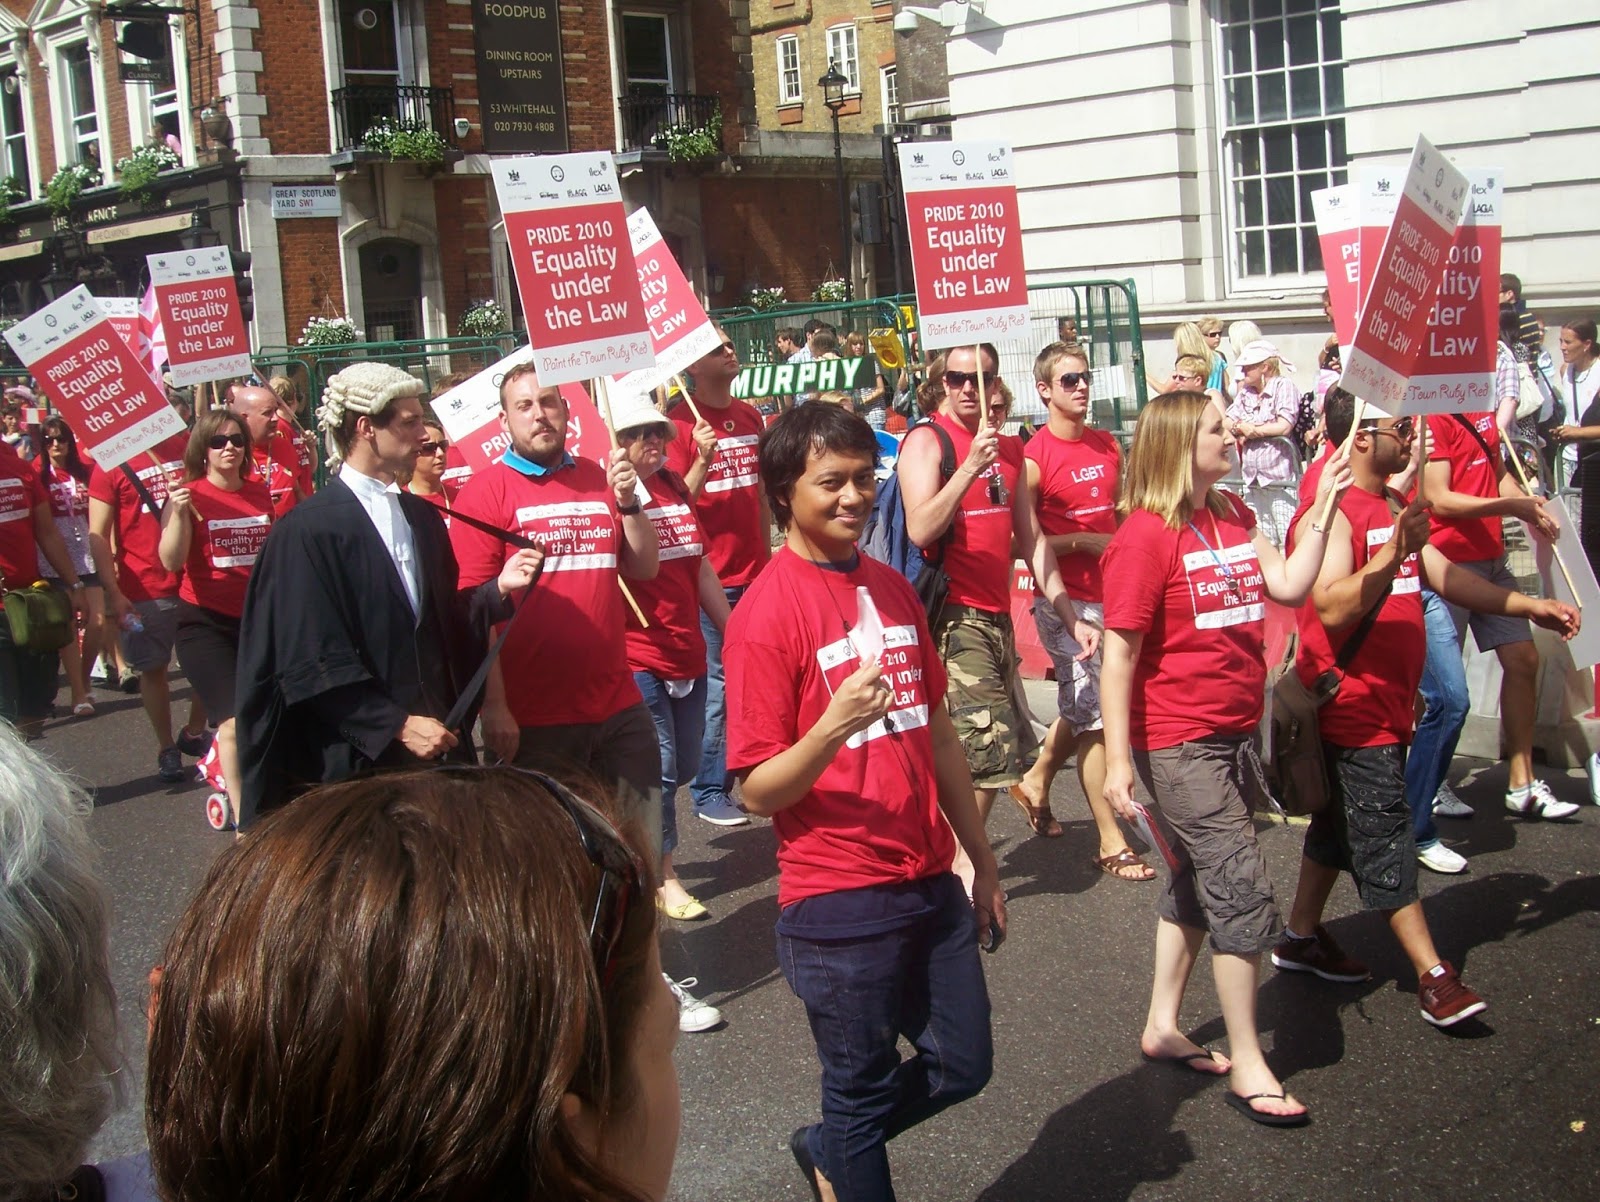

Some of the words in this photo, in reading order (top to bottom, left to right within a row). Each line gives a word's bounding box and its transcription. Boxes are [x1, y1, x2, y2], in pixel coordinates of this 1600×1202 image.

[485, 3, 546, 19] FOODPUB
[486, 50, 522, 61] DINING
[524, 52, 553, 62] ROOM
[500, 69, 542, 79] UPSTAIRS
[490, 103, 501, 113] 53
[502, 104, 556, 114] WHITEHALL
[494, 121, 511, 131] 020
[512, 122, 533, 132] 7930
[534, 122, 555, 132] 4808
[275, 189, 297, 198] GREAT
[301, 188, 337, 198] SCOTLAND
[276, 199, 296, 208] YARD
[298, 199, 314, 207] SW1
[924, 205, 965, 223] PRIDE
[969, 202, 1004, 219] 2010
[526, 225, 573, 246] PRIDE
[575, 220, 613, 240] 2010
[927, 223, 1006, 252] Equality
[1398, 220, 1420, 253] PRIDE
[1419, 238, 1440, 267] 2010
[531, 244, 617, 277] Equality
[941, 249, 998, 273] under
[1446, 245, 1482, 264] 010
[1388, 245, 1431, 301] Equality
[168, 291, 199, 305] PRIDE
[201, 287, 227, 300] 2010
[551, 273, 612, 300] under
[933, 277, 967, 300] the
[972, 274, 1011, 296] Law
[171, 302, 229, 323] Equality
[1383, 286, 1416, 322] under
[1427, 301, 1466, 326] der
[545, 305, 582, 330] the
[587, 300, 628, 323] Law
[927, 323, 948, 336] Paint
[949, 321, 962, 333] the
[961, 319, 985, 332] Town
[986, 316, 1008, 333] Ruby
[1008, 313, 1025, 325] Red
[183, 320, 224, 337] under
[650, 309, 687, 341] Law
[1368, 309, 1389, 341] the
[1387, 320, 1411, 356] Law
[178, 339, 203, 354] the
[206, 335, 235, 350] Law
[1429, 332, 1478, 357] Law
[47, 355, 82, 382] PRIDE
[79, 338, 110, 363] 2010
[542, 357, 567, 372] Paint
[567, 353, 581, 367] the
[580, 350, 607, 365] Town
[607, 344, 631, 363] Ruby
[630, 341, 648, 354] Red
[57, 356, 123, 399] Equality
[730, 358, 862, 398] MURPHY
[80, 378, 126, 411] under
[1408, 386, 1437, 400] Town
[1438, 384, 1467, 404] Ruby
[1468, 382, 1488, 397] Red
[84, 411, 115, 433] the
[111, 391, 148, 417] Law
[121, 435, 143, 449] Town
[141, 422, 164, 441] Ruby
[160, 413, 175, 426] Red
[1475, 416, 1492, 433] GBT
[735, 447, 750, 456] 2010
[741, 454, 759, 465] unde
[1071, 465, 1105, 484] LGBT
[0, 504, 13, 512] aw
[249, 527, 266, 535] 2010
[549, 517, 572, 528] PRIDE
[572, 517, 591, 527] 2010
[664, 517, 681, 526] 2010
[214, 535, 254, 548] Equality
[528, 528, 577, 545] Equality
[579, 527, 613, 539] under
[672, 535, 692, 545] Law
[231, 546, 247, 555] the
[551, 543, 571, 555] the
[573, 542, 596, 553] Law
[1233, 563, 1253, 574] 2010
[1243, 571, 1263, 588] und
[1223, 592, 1239, 607] the
[1240, 591, 1259, 603] Law
